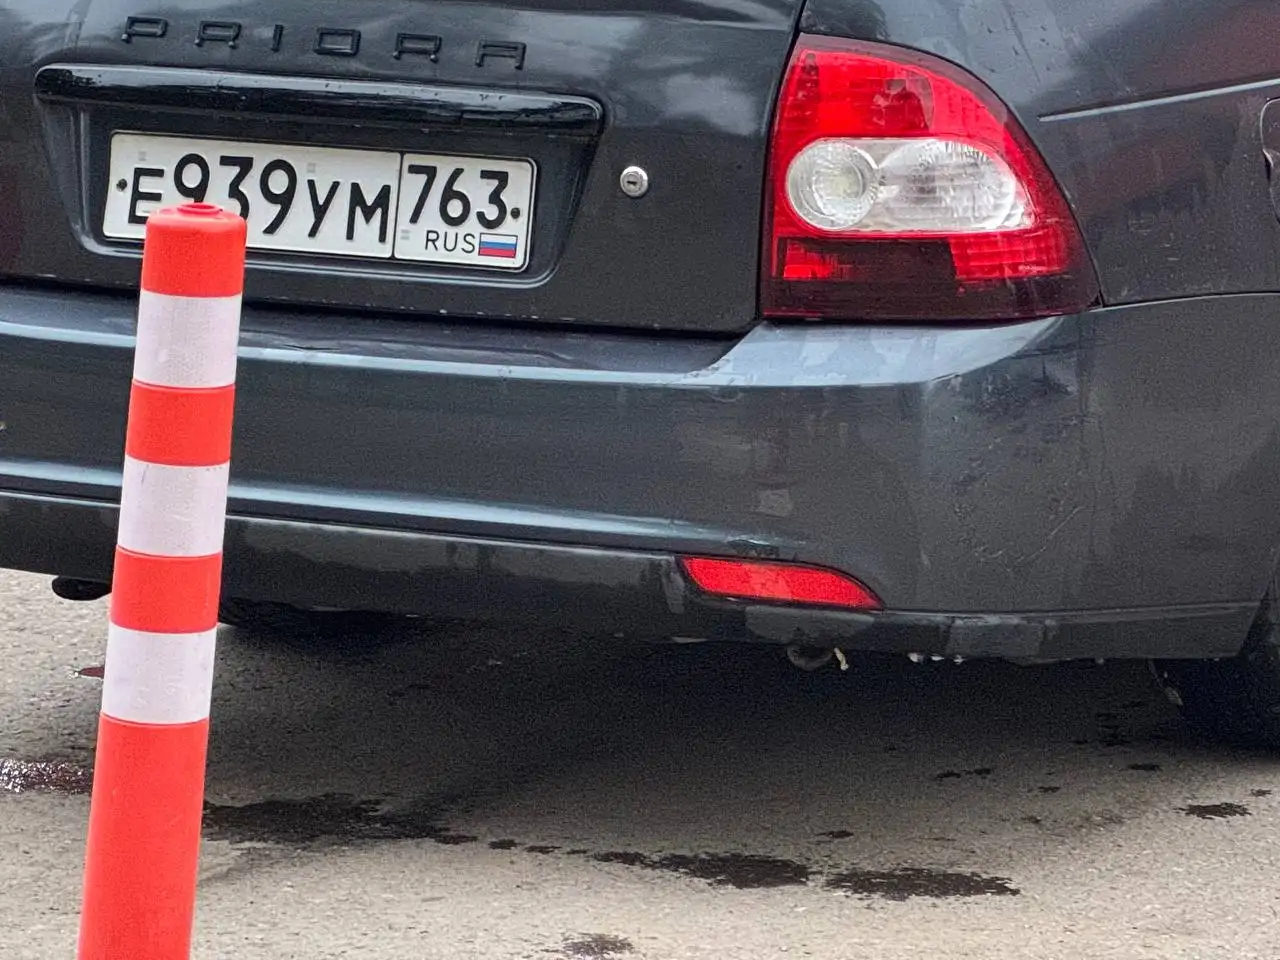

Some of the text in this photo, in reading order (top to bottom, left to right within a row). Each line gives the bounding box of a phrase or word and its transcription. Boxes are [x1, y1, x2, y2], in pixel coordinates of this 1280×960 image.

[121, 16, 527, 71] PRIORA
[407, 164, 509, 230] 763
[424, 229, 476, 254] RUS
